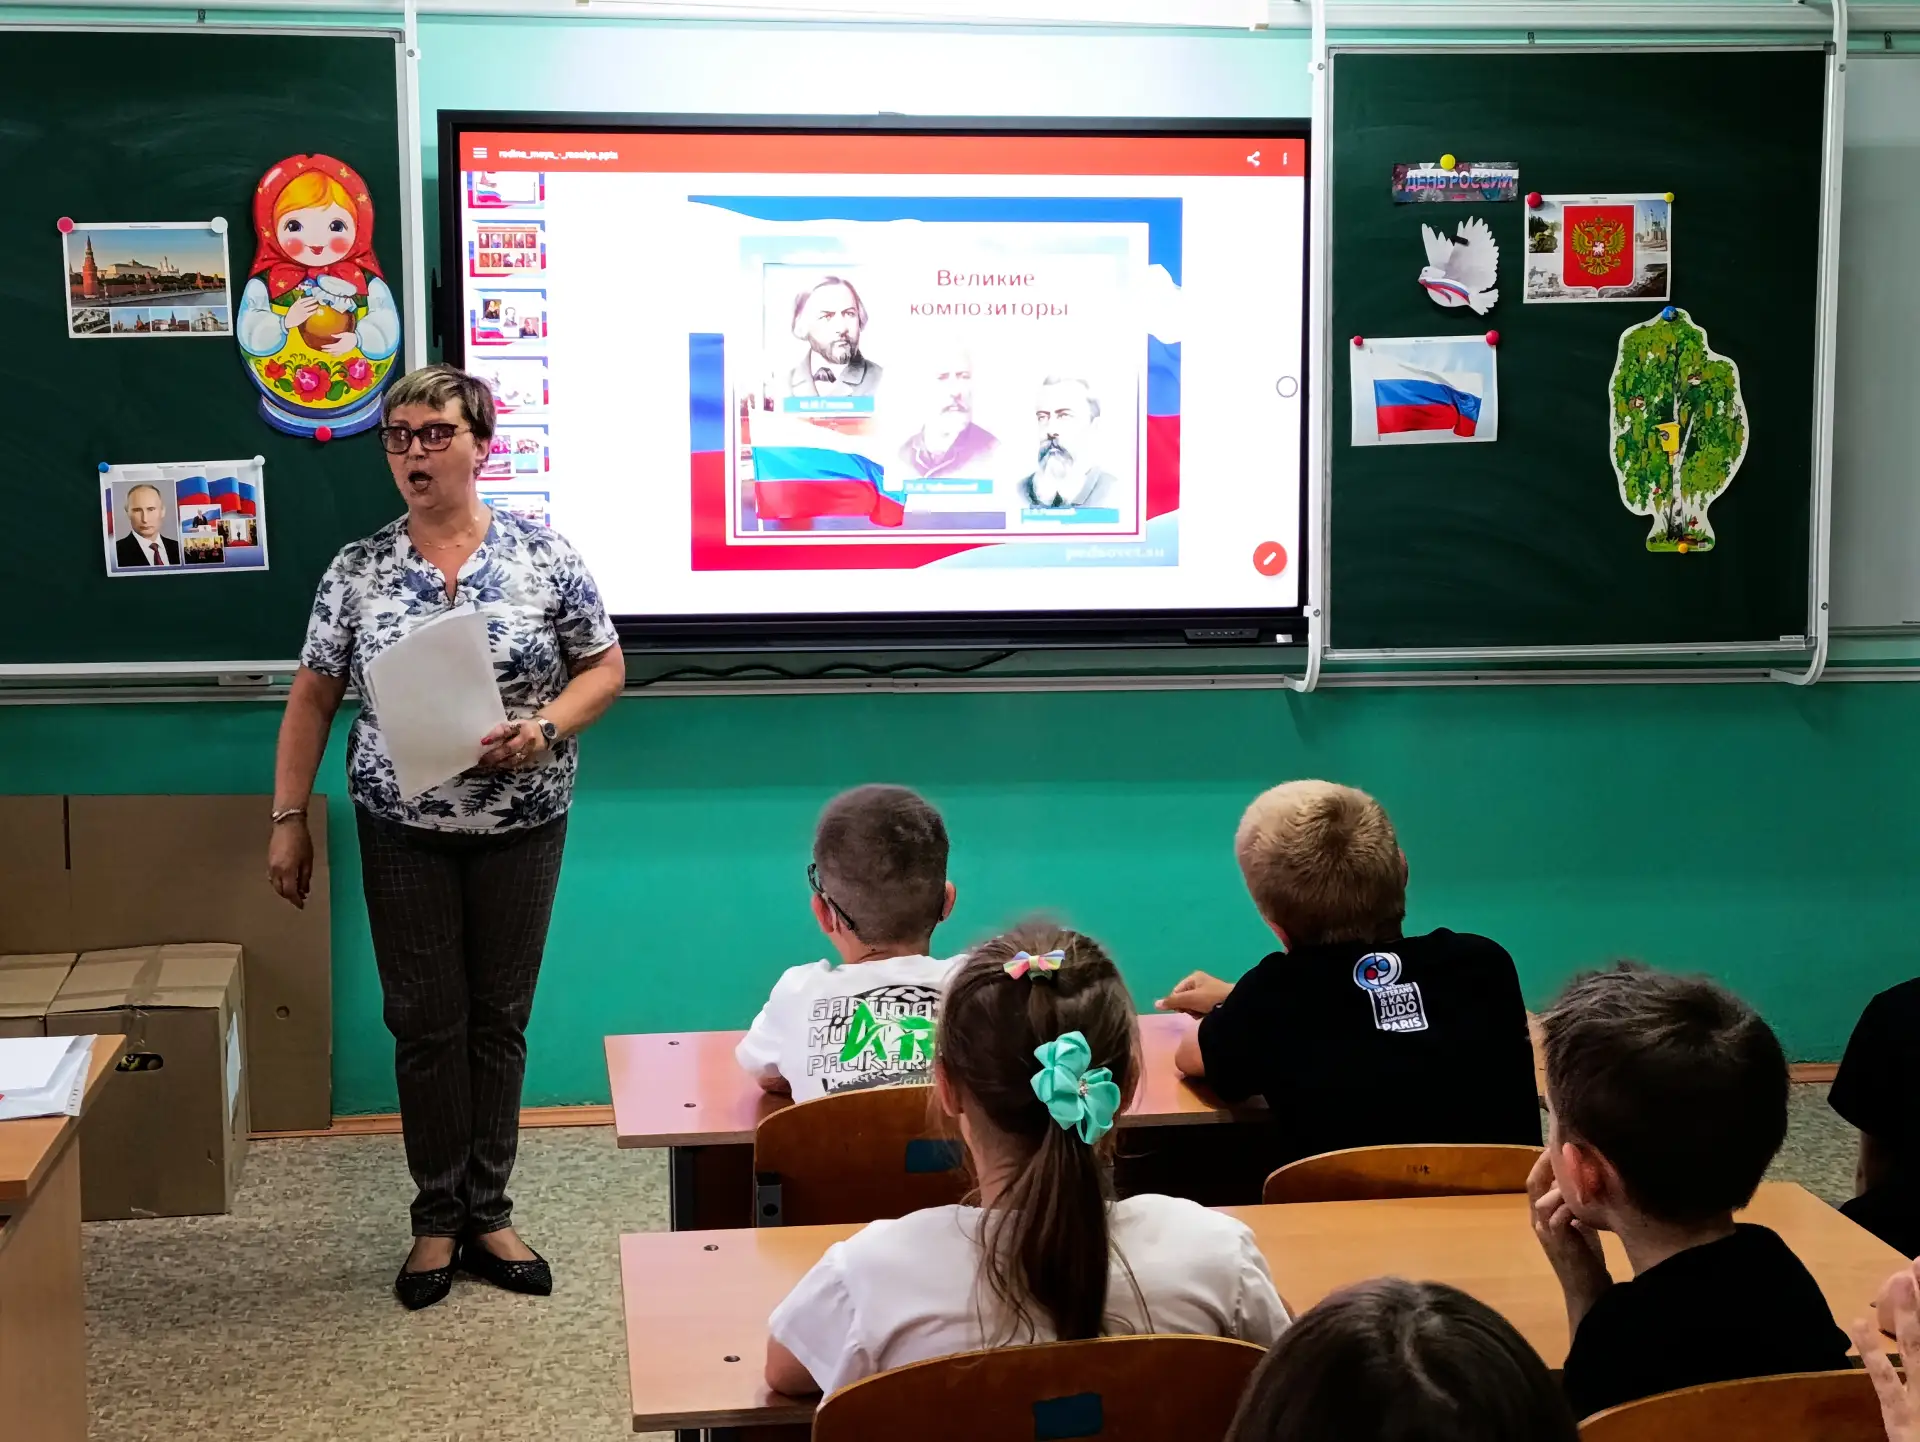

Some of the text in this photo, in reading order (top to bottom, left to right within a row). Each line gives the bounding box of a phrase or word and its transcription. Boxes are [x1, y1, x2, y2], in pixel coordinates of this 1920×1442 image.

[1405, 169, 1513, 192] ДЕНЬ РОССИИ
[937, 269, 1035, 286] Великие
[910, 302, 1068, 320] композиторы
[1376, 987, 1414, 999] VETERANS
[1380, 992, 1415, 1007] & KATA
[1380, 1001, 1417, 1019] JUDO
[1382, 1017, 1422, 1031] PARIS
